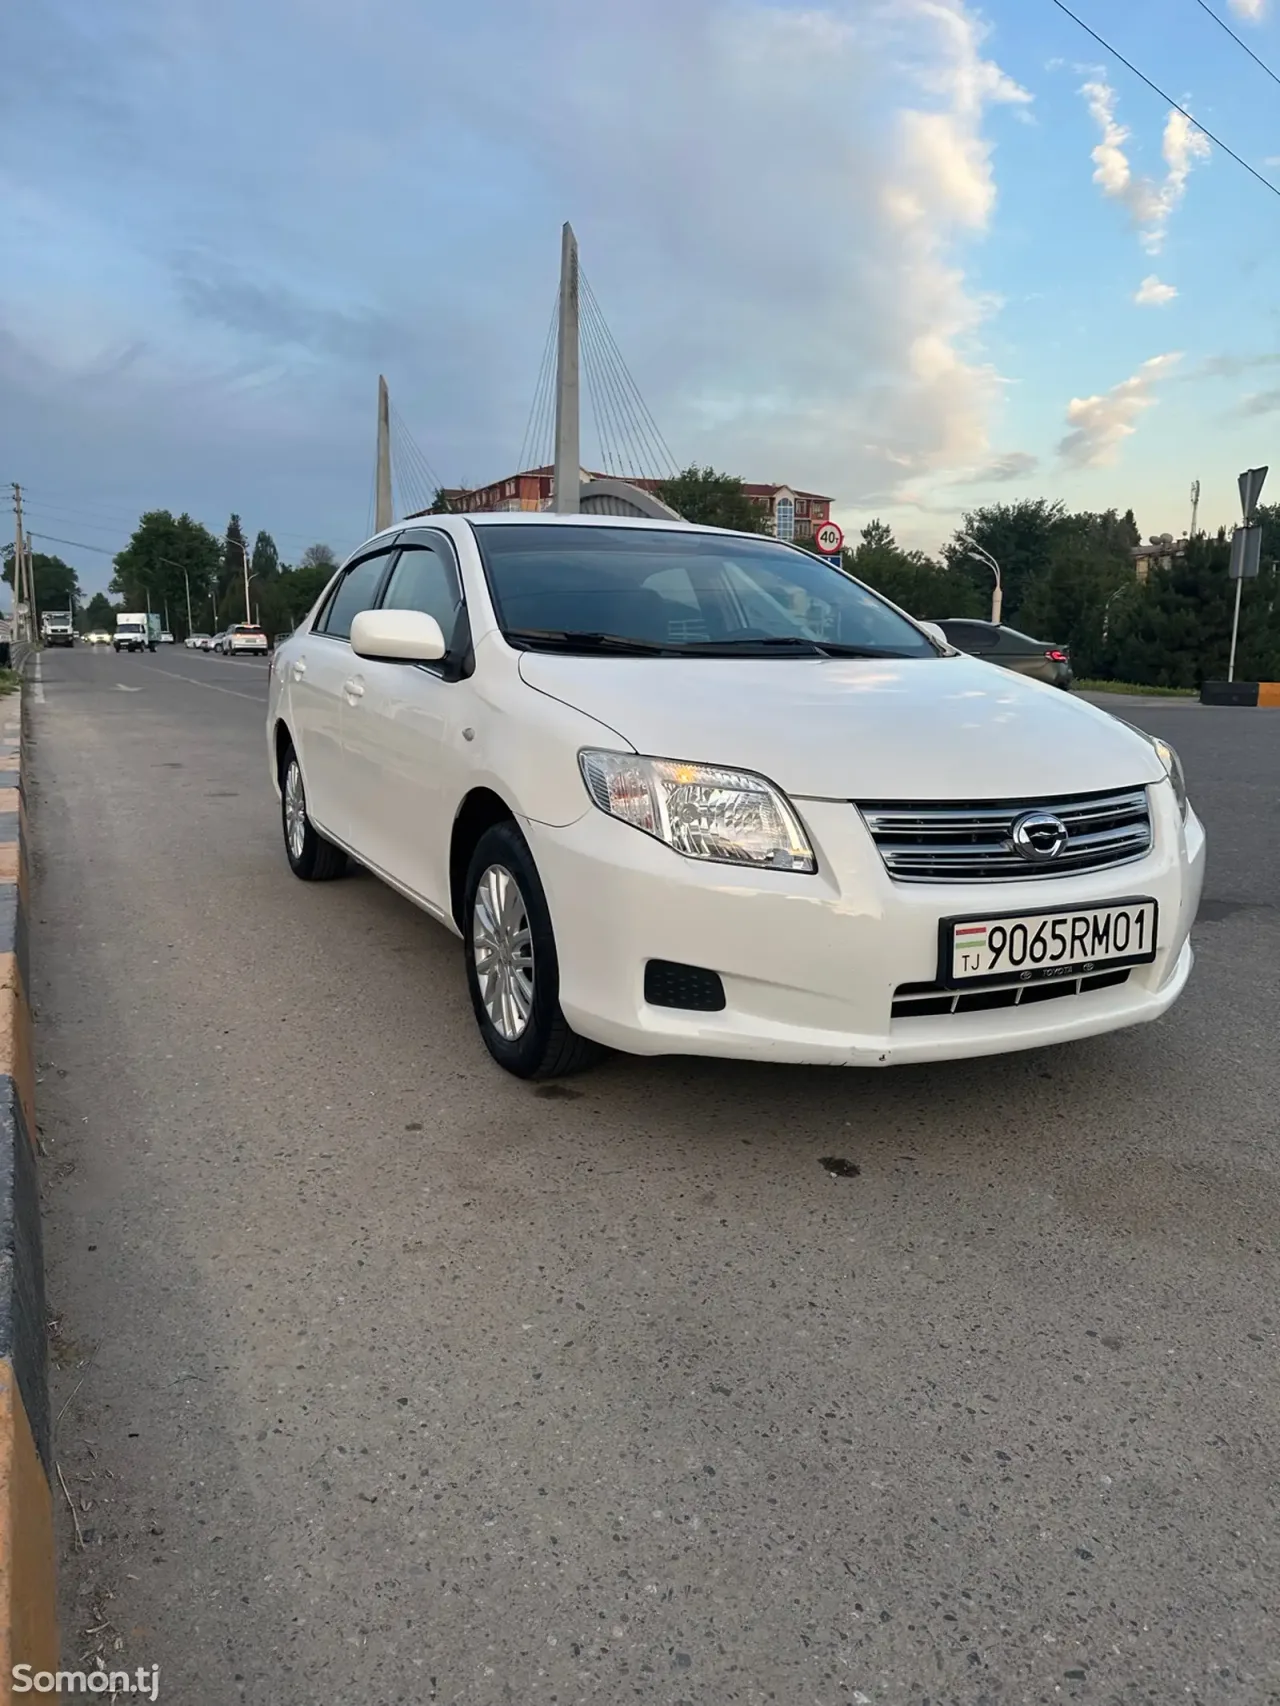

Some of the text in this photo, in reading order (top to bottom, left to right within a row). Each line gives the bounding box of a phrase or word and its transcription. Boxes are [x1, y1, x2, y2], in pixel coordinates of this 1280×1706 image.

[987, 908, 1145, 970] 9065RM01
[962, 954, 980, 971] TJ
[1042, 966, 1073, 977] TOYOTA
